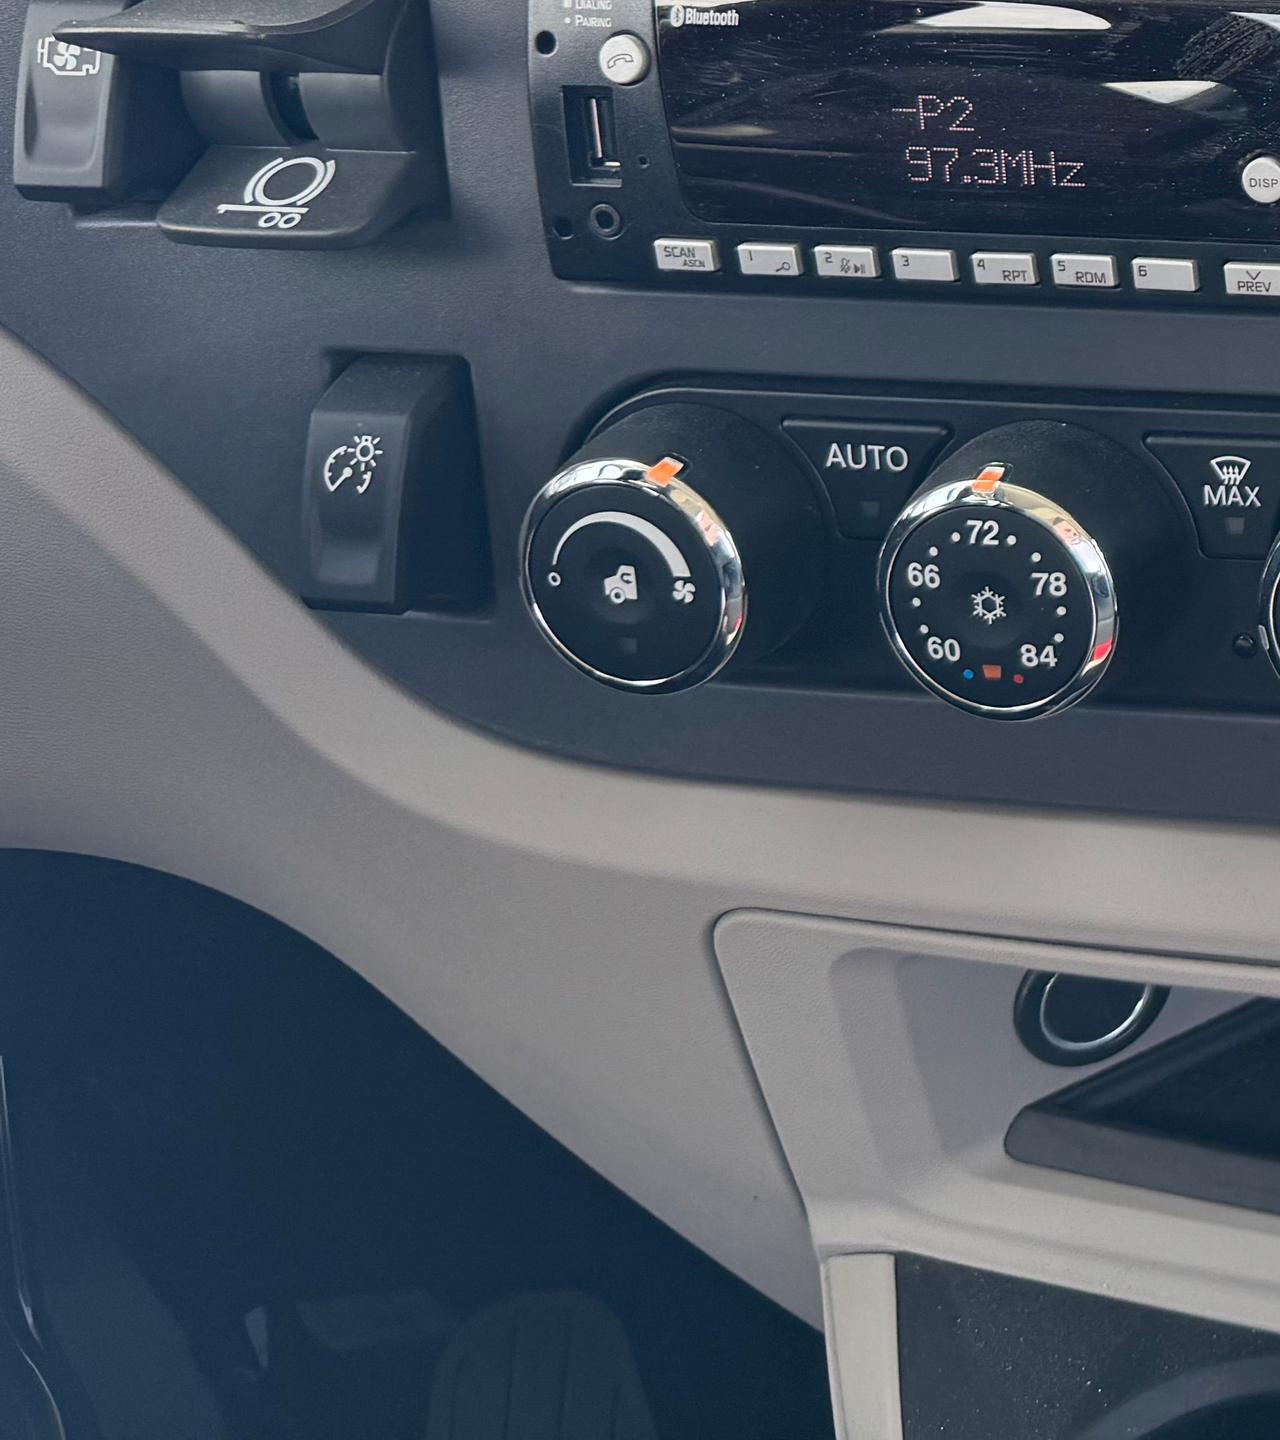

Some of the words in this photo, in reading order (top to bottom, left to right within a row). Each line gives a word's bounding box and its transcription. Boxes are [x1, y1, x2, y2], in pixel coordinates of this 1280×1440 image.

[684, 8, 740, 27] Bluetooth
[906, 146, 1086, 187] 97.3MHz
[1249, 178, 1278, 189] DISP
[664, 246, 696, 258] SCAN
[824, 252, 833, 264] 2
[902, 256, 910, 267] 3
[977, 259, 986, 271] 4
[1058, 260, 1066, 272] 5
[1003, 270, 1028, 282] RPT
[1075, 271, 1106, 284] RDM
[1138, 266, 1148, 277] 6
[1238, 281, 1272, 292] PREV
[825, 443, 908, 472] AUTO
[1204, 484, 1262, 508] MAX
[966, 520, 1000, 546] 72
[907, 562, 941, 589] 66
[1031, 572, 1068, 597] 78
[927, 636, 961, 662] 60
[1020, 644, 1058, 668] 84
